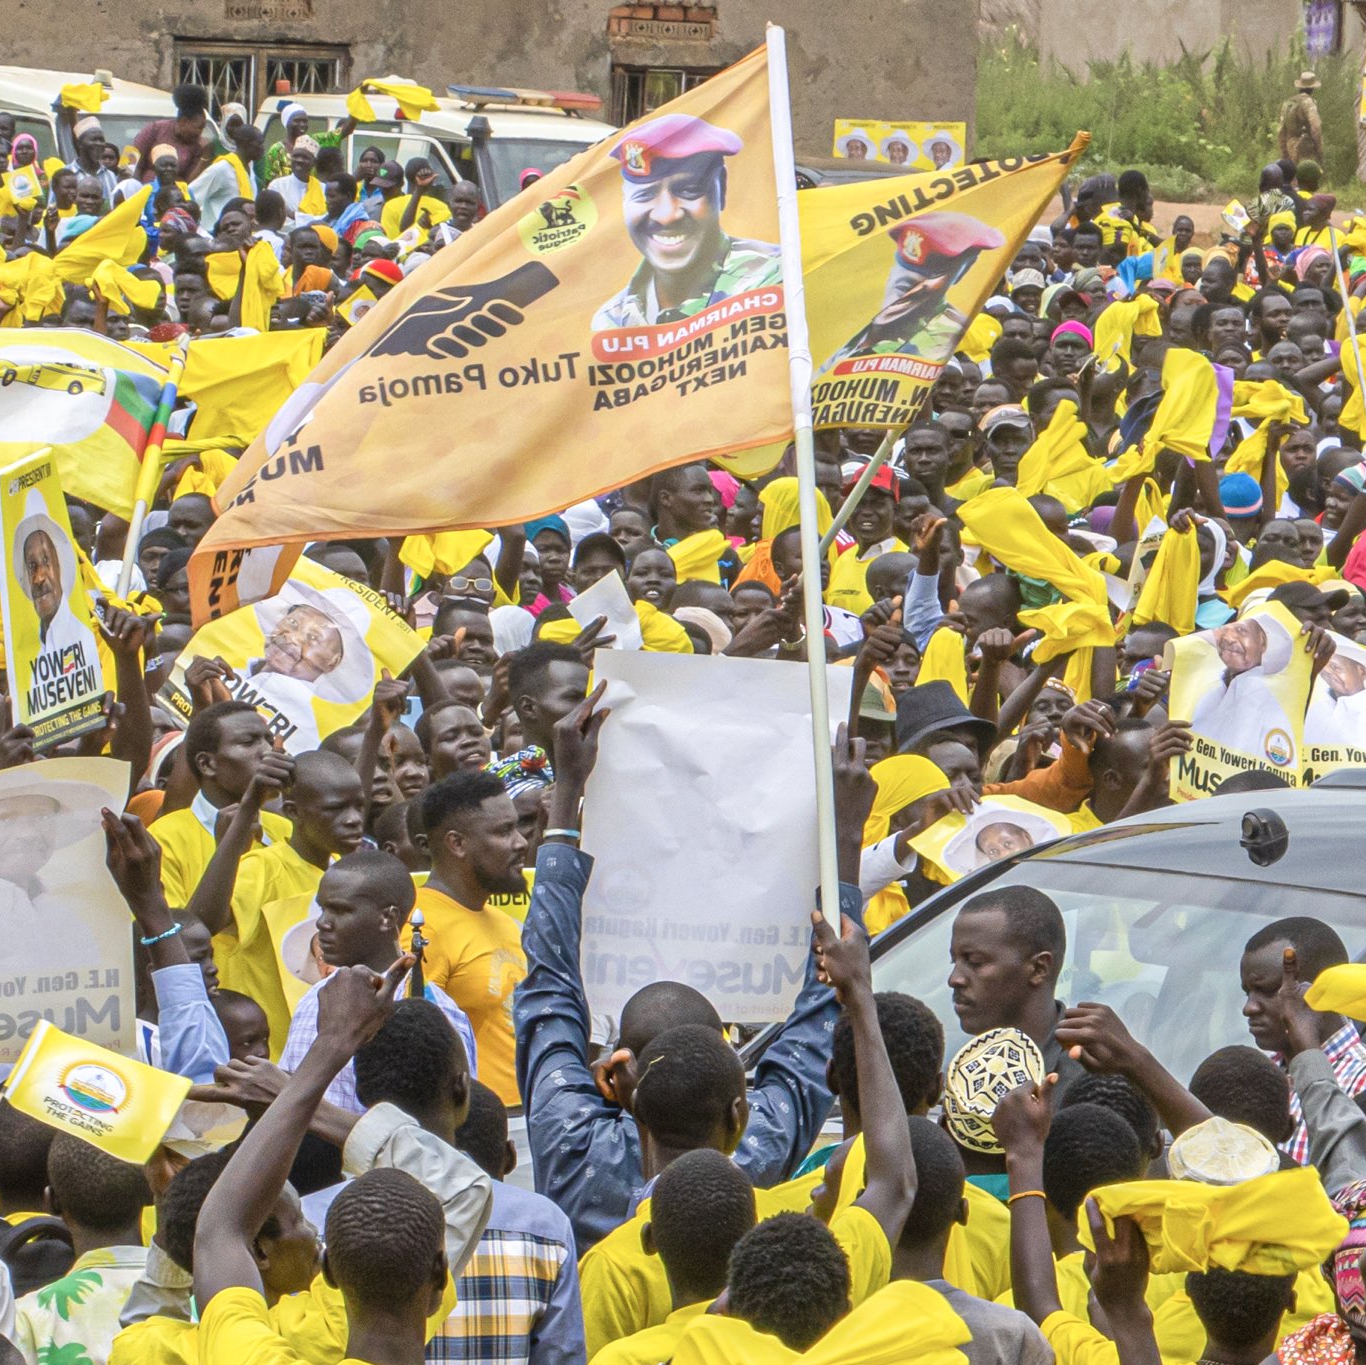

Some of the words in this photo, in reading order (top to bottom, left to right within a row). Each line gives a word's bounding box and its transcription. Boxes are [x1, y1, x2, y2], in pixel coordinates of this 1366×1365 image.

[30, 641, 86, 685] YOWERI
[27, 665, 96, 716] MUSEVENI
[1196, 738, 1217, 760] Gen.
[1220, 747, 1257, 770] Yoweri
[1311, 747, 1343, 762] Gen.
[43, 1096, 114, 1132] PROTECTING
[46, 1106, 67, 1121] THE
[69, 1117, 104, 1137] GAINS
